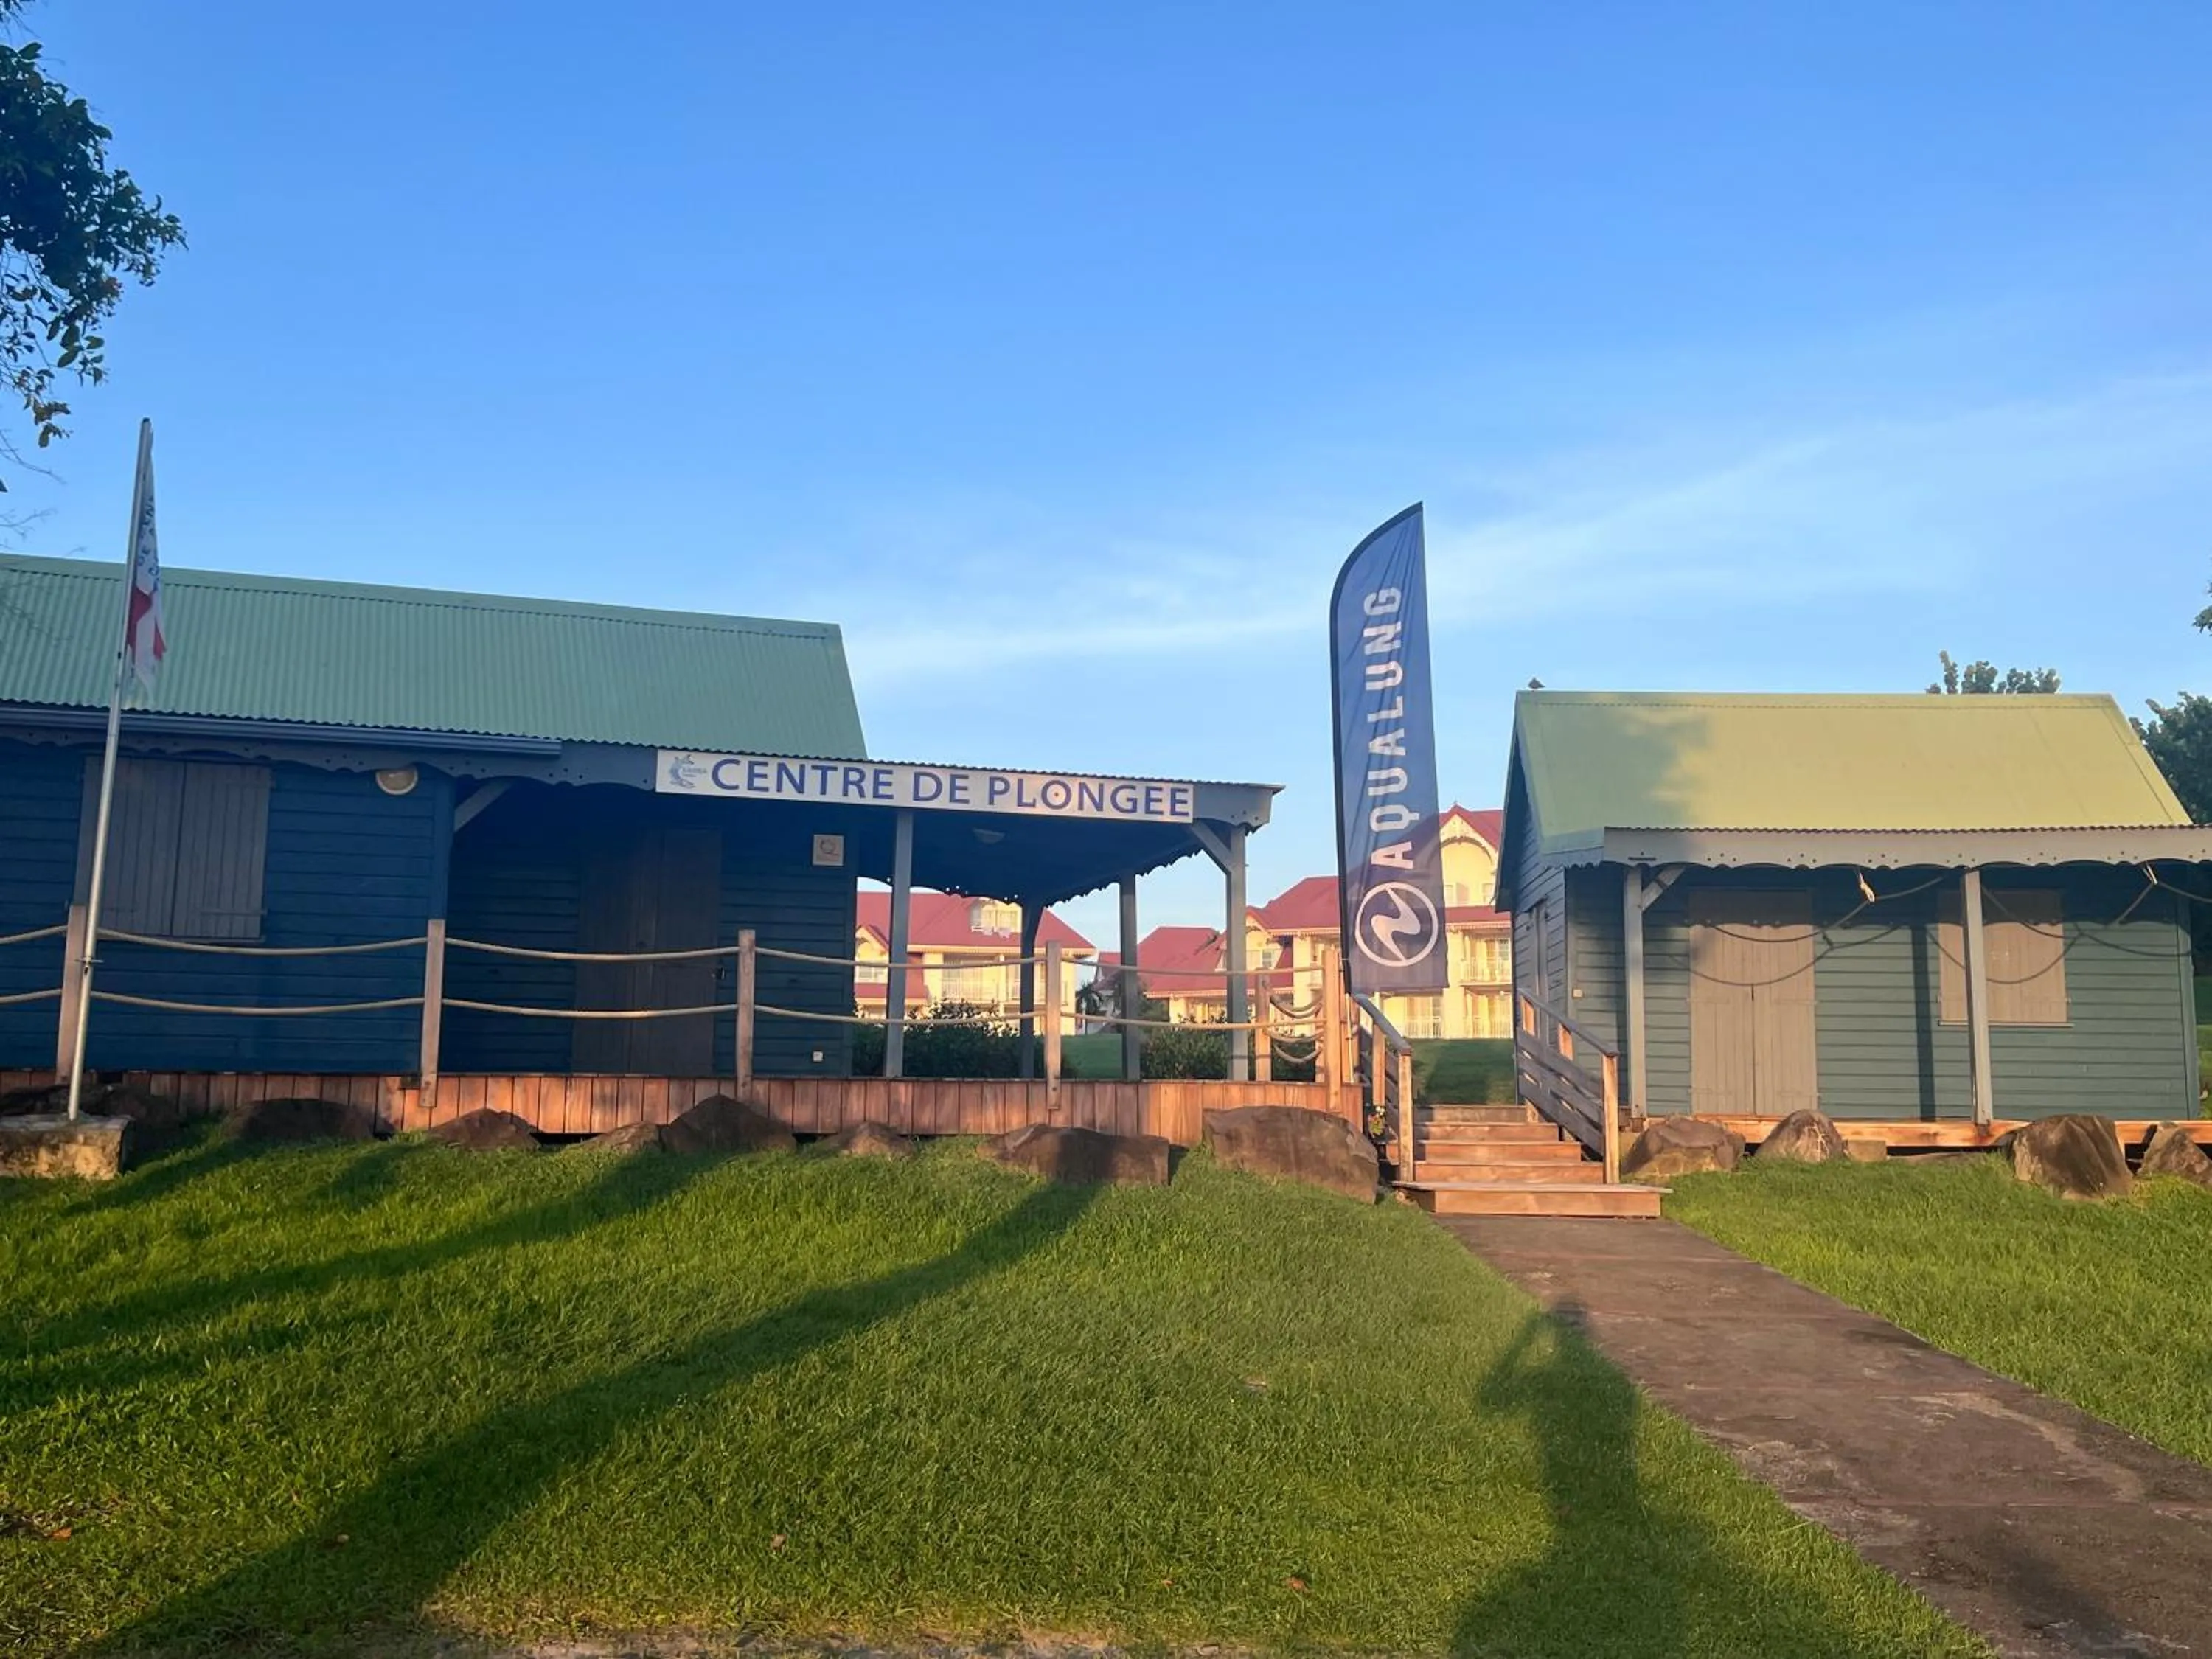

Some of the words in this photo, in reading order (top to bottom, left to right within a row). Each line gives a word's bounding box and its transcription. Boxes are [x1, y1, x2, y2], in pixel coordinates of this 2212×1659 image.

[712, 758, 894, 800] CENTRE
[913, 771, 970, 804] DE
[987, 776, 1189, 817] PLONGEE
[1363, 586, 1420, 870] AQUALUNG
